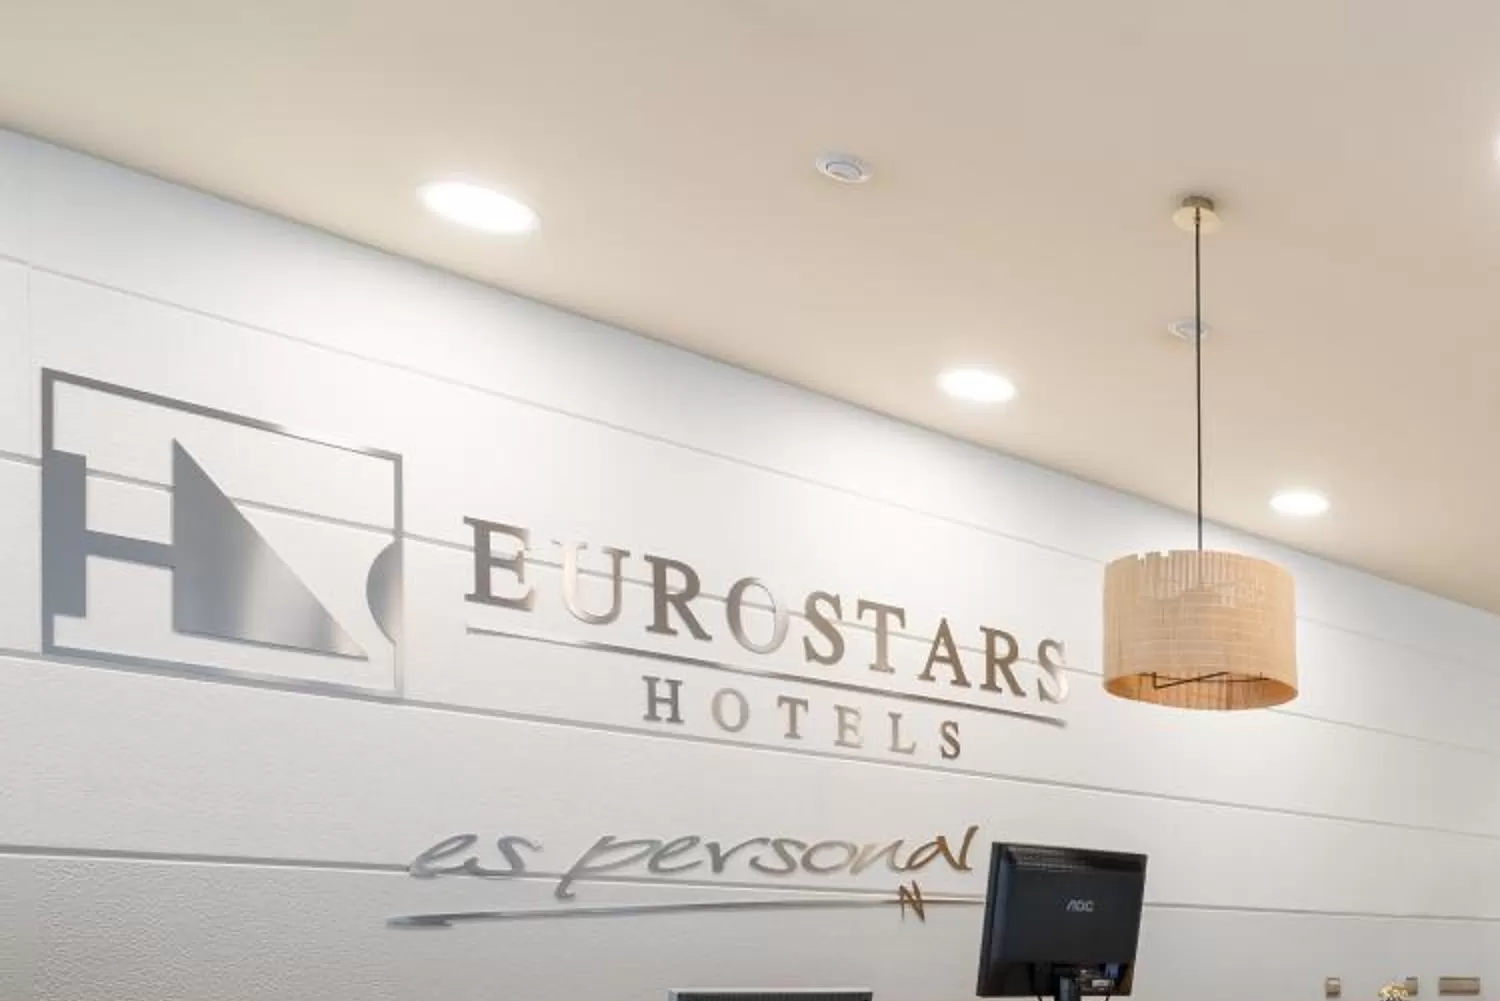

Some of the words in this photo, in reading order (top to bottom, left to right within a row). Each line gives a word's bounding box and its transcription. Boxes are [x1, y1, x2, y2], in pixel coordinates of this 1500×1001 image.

[463, 515, 1069, 703] EUROSTARS
[642, 675, 962, 761] HOTELS
[408, 832, 544, 878] es
[554, 825, 979, 899] personal
